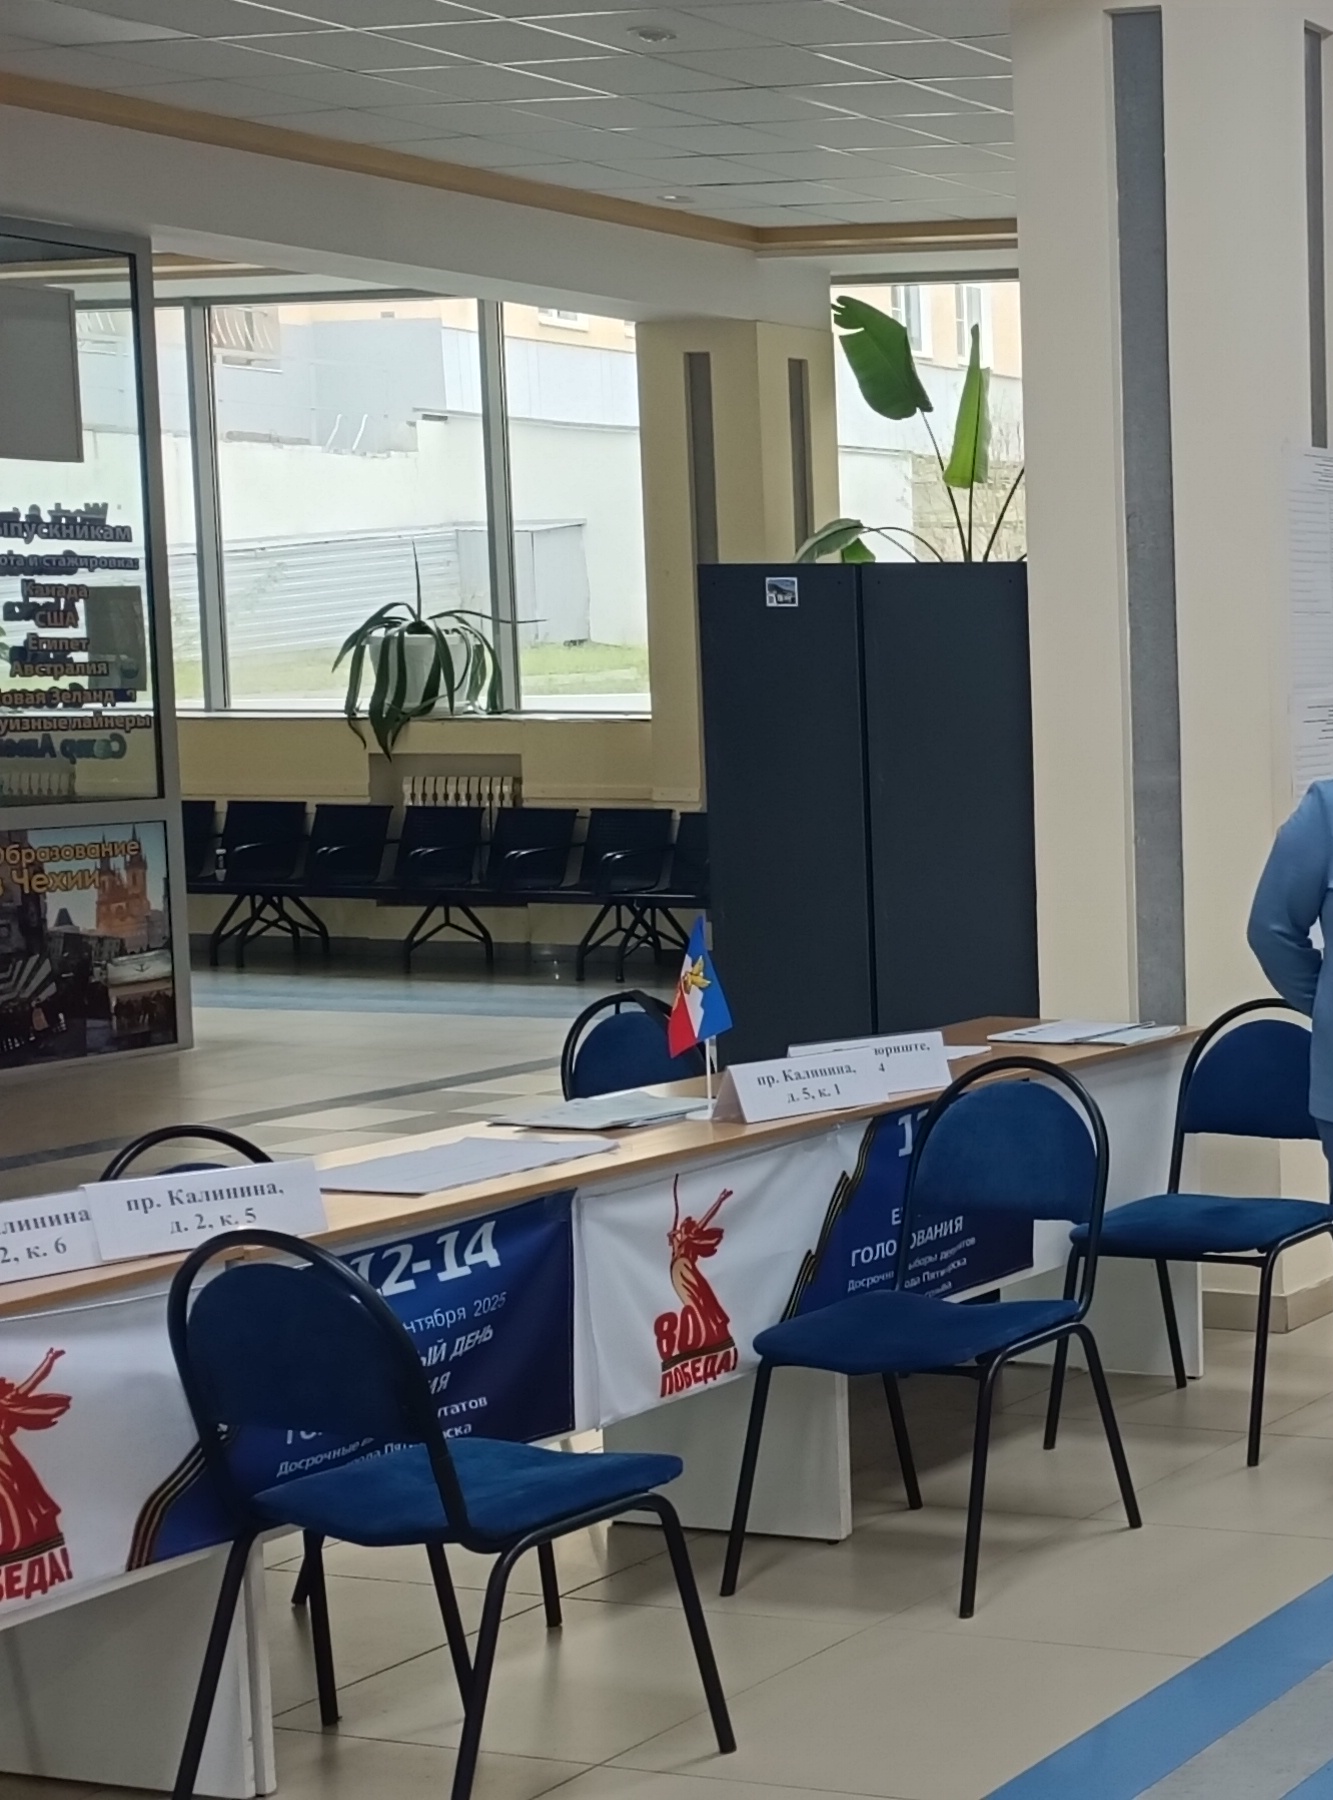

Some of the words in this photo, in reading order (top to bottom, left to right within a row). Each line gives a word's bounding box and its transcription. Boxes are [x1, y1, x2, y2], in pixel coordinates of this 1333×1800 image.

[0, 521, 132, 544] ыпускникам
[23, 580, 88, 600] Канада
[35, 611, 78, 627] США
[27, 634, 89, 652] Египет
[10, 661, 108, 679] Австралия
[0, 689, 46, 706] овая
[50, 688, 136, 707] Зеланд
[0, 717, 69, 736] уизные
[11, 868, 101, 894] Чехии
[873, 1042, 931, 1058] юриште,
[757, 1072, 780, 1089] пр.
[783, 1062, 857, 1083] Калинина,
[818, 1087, 832, 1098] к.
[126, 1196, 161, 1214] пр.
[167, 1180, 285, 1206] Калинина,
[0, 1208, 91, 1235] линина
[169, 1217, 189, 1235] д.
[196, 1213, 214, 1231] 2,
[219, 1211, 240, 1227] к.
[244, 1207, 258, 1225] 5
[26, 1245, 48, 1260] к.
[54, 1236, 67, 1255] 6
[851, 1215, 964, 1268] ГОЛОВАНИЯ
[350, 1220, 501, 1298] 12-14
[403, 1305, 467, 1335] нтября
[473, 1291, 507, 1318] 2025
[450, 1323, 494, 1362] ДЕНЬ
[653, 1305, 703, 1361] 80
[660, 1347, 738, 1398] ПОБЕДА!
[0, 1547, 73, 1602] ЕДА!
